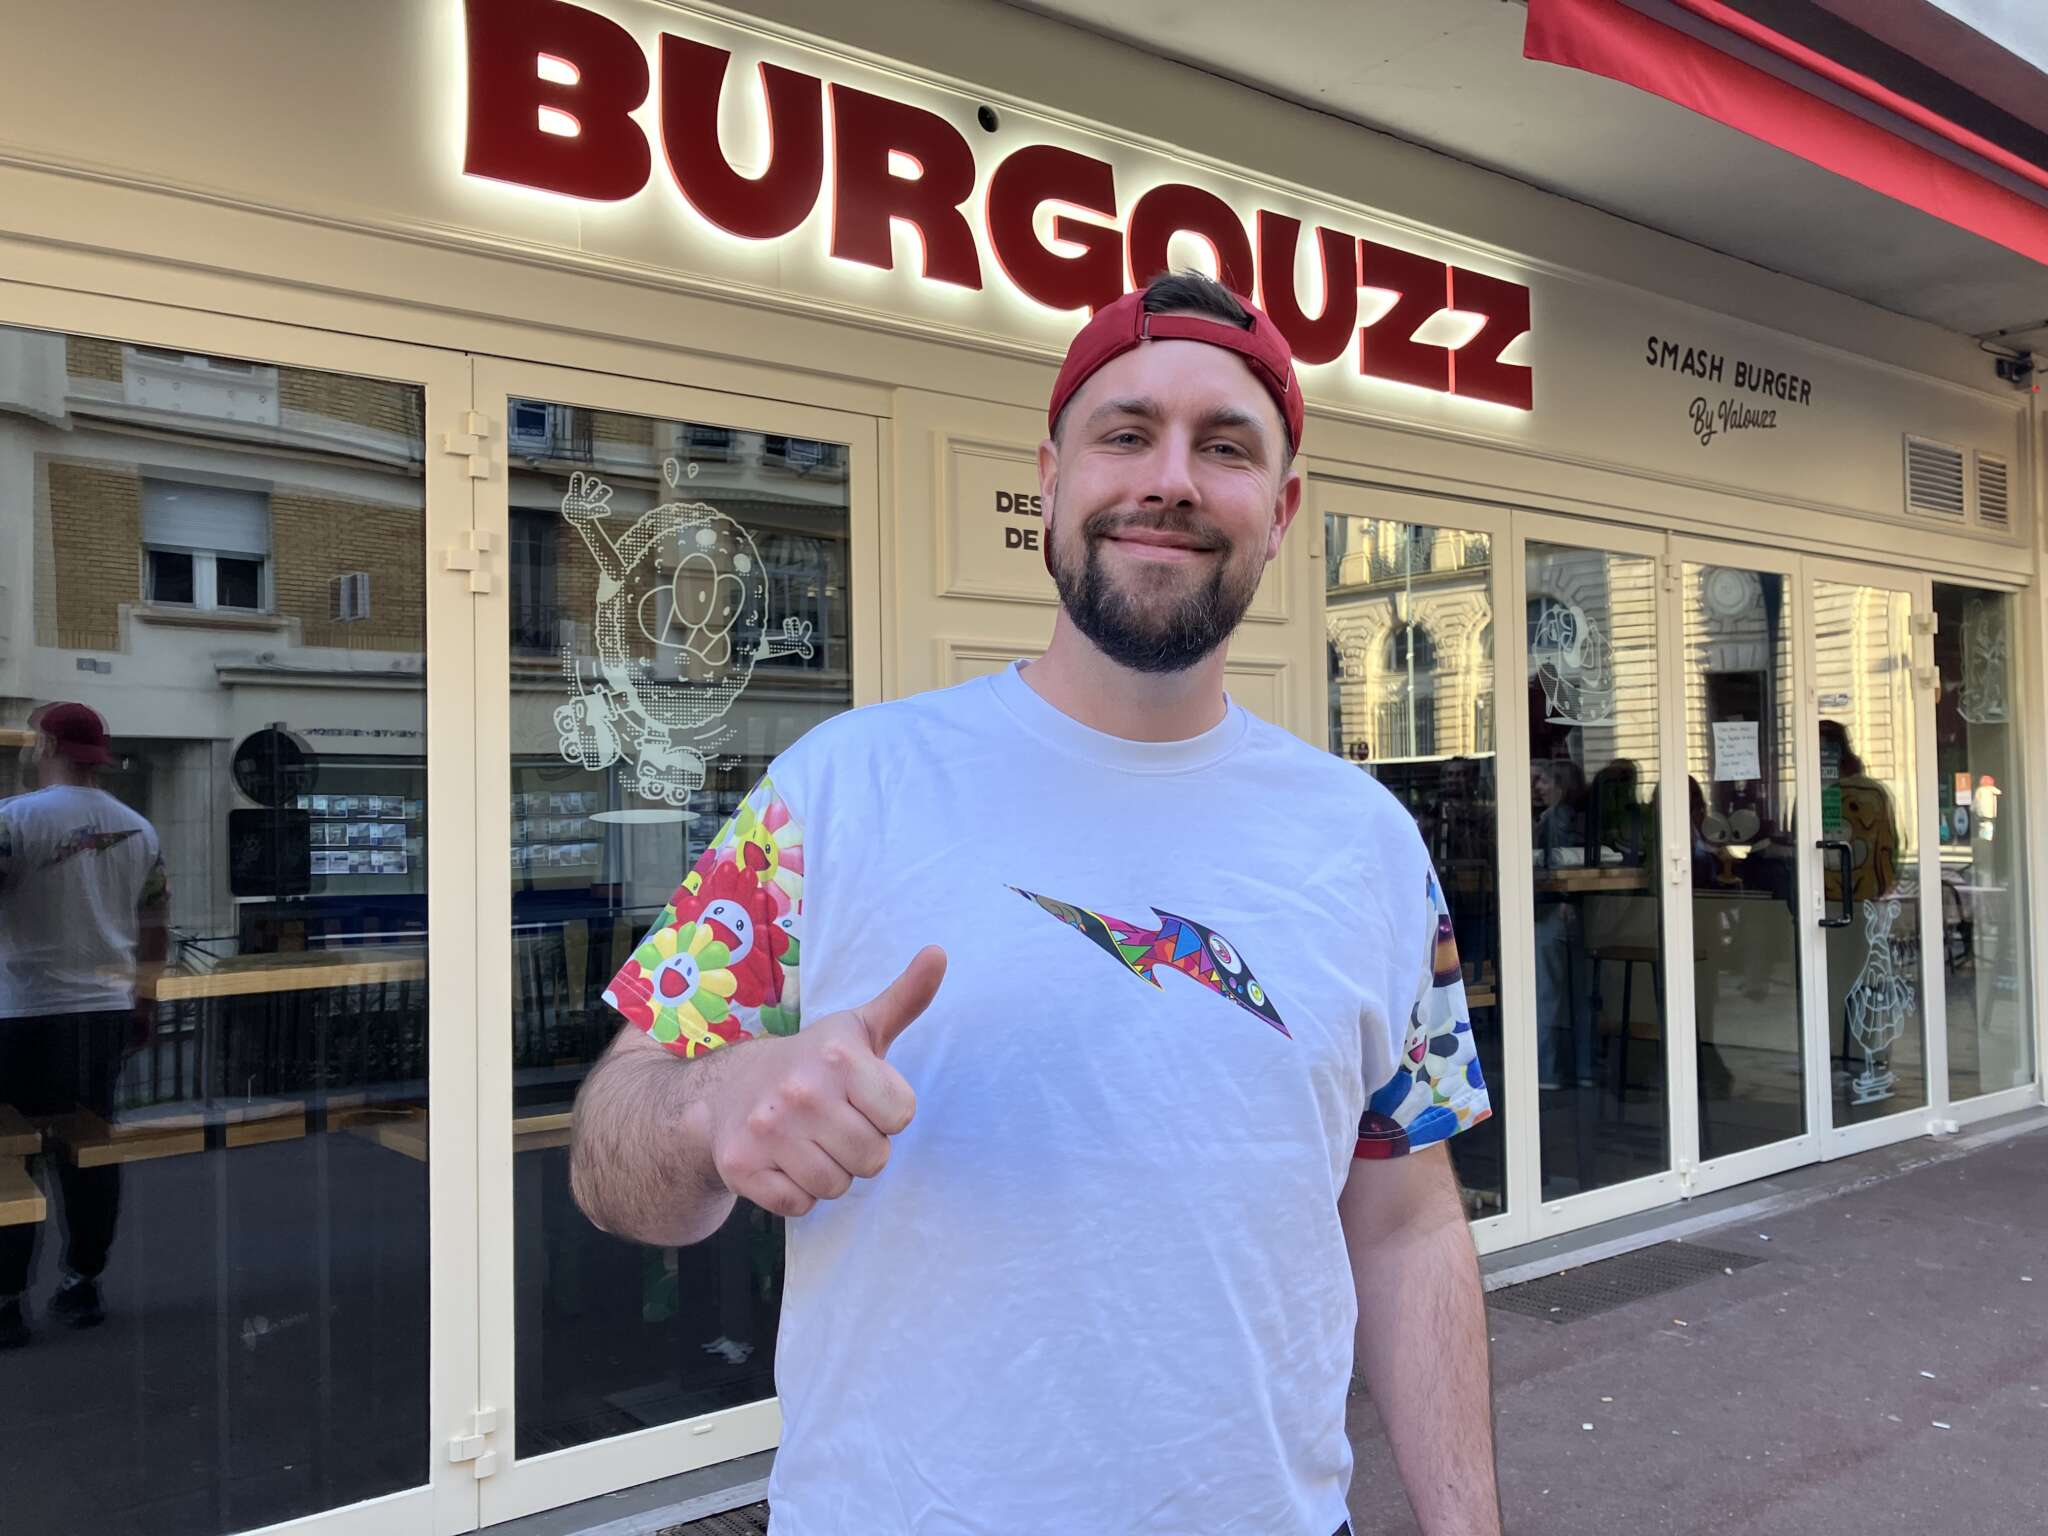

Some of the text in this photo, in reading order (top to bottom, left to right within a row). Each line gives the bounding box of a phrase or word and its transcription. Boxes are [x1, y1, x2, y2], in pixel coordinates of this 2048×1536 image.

[464, 0, 1533, 409] BURGOUZZ
[1646, 336, 1811, 405] SMASH BURGER
[1689, 397, 1777, 446] By Valouzz
[996, 490, 1042, 517] DES
[1005, 527, 1039, 551] DE
